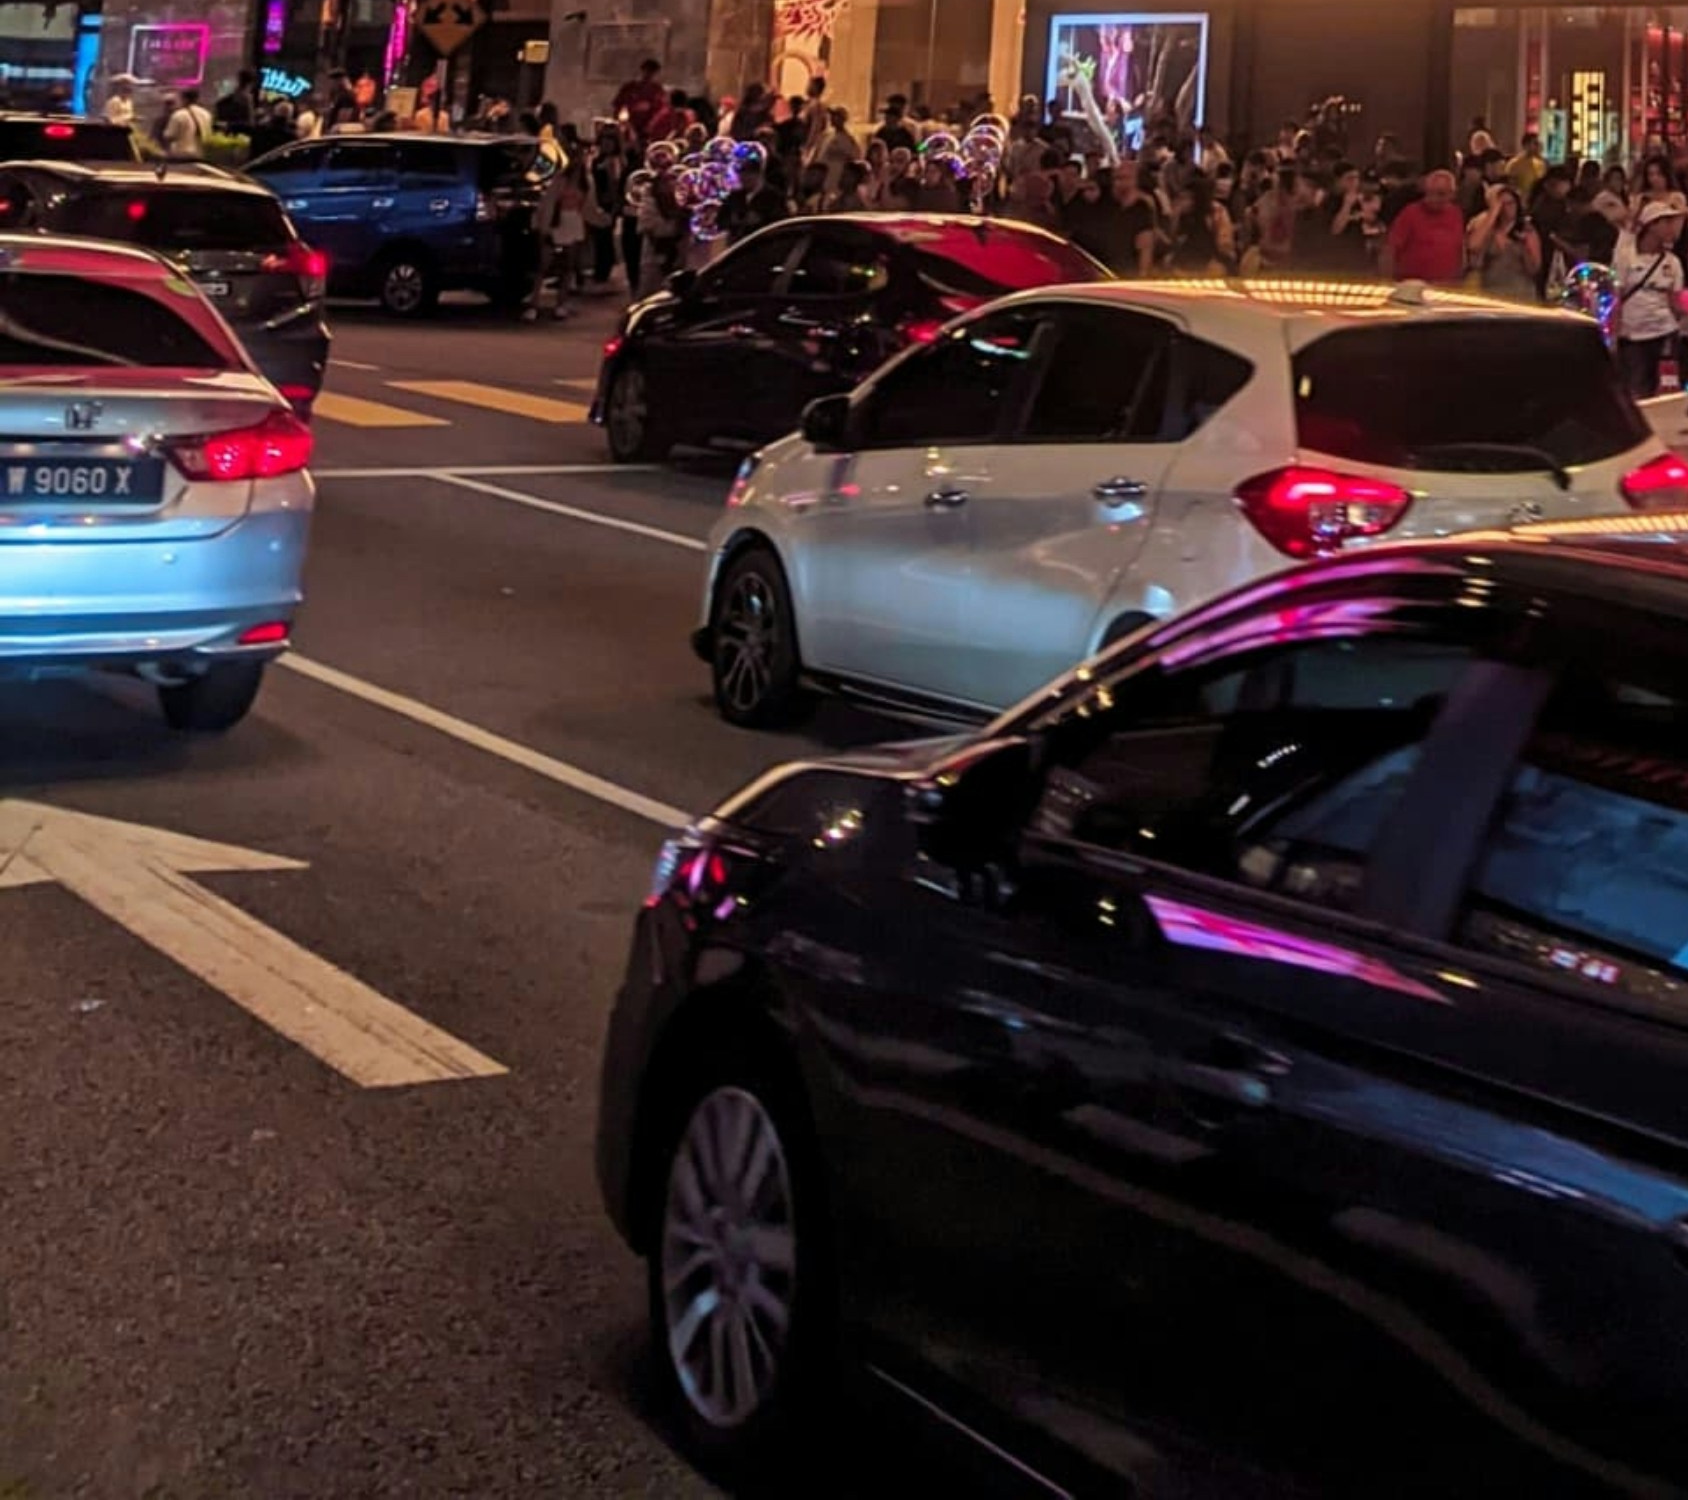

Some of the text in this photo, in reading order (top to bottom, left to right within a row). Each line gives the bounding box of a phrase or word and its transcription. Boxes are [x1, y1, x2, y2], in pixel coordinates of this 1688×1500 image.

[8, 466, 131, 495] W 9060 X
